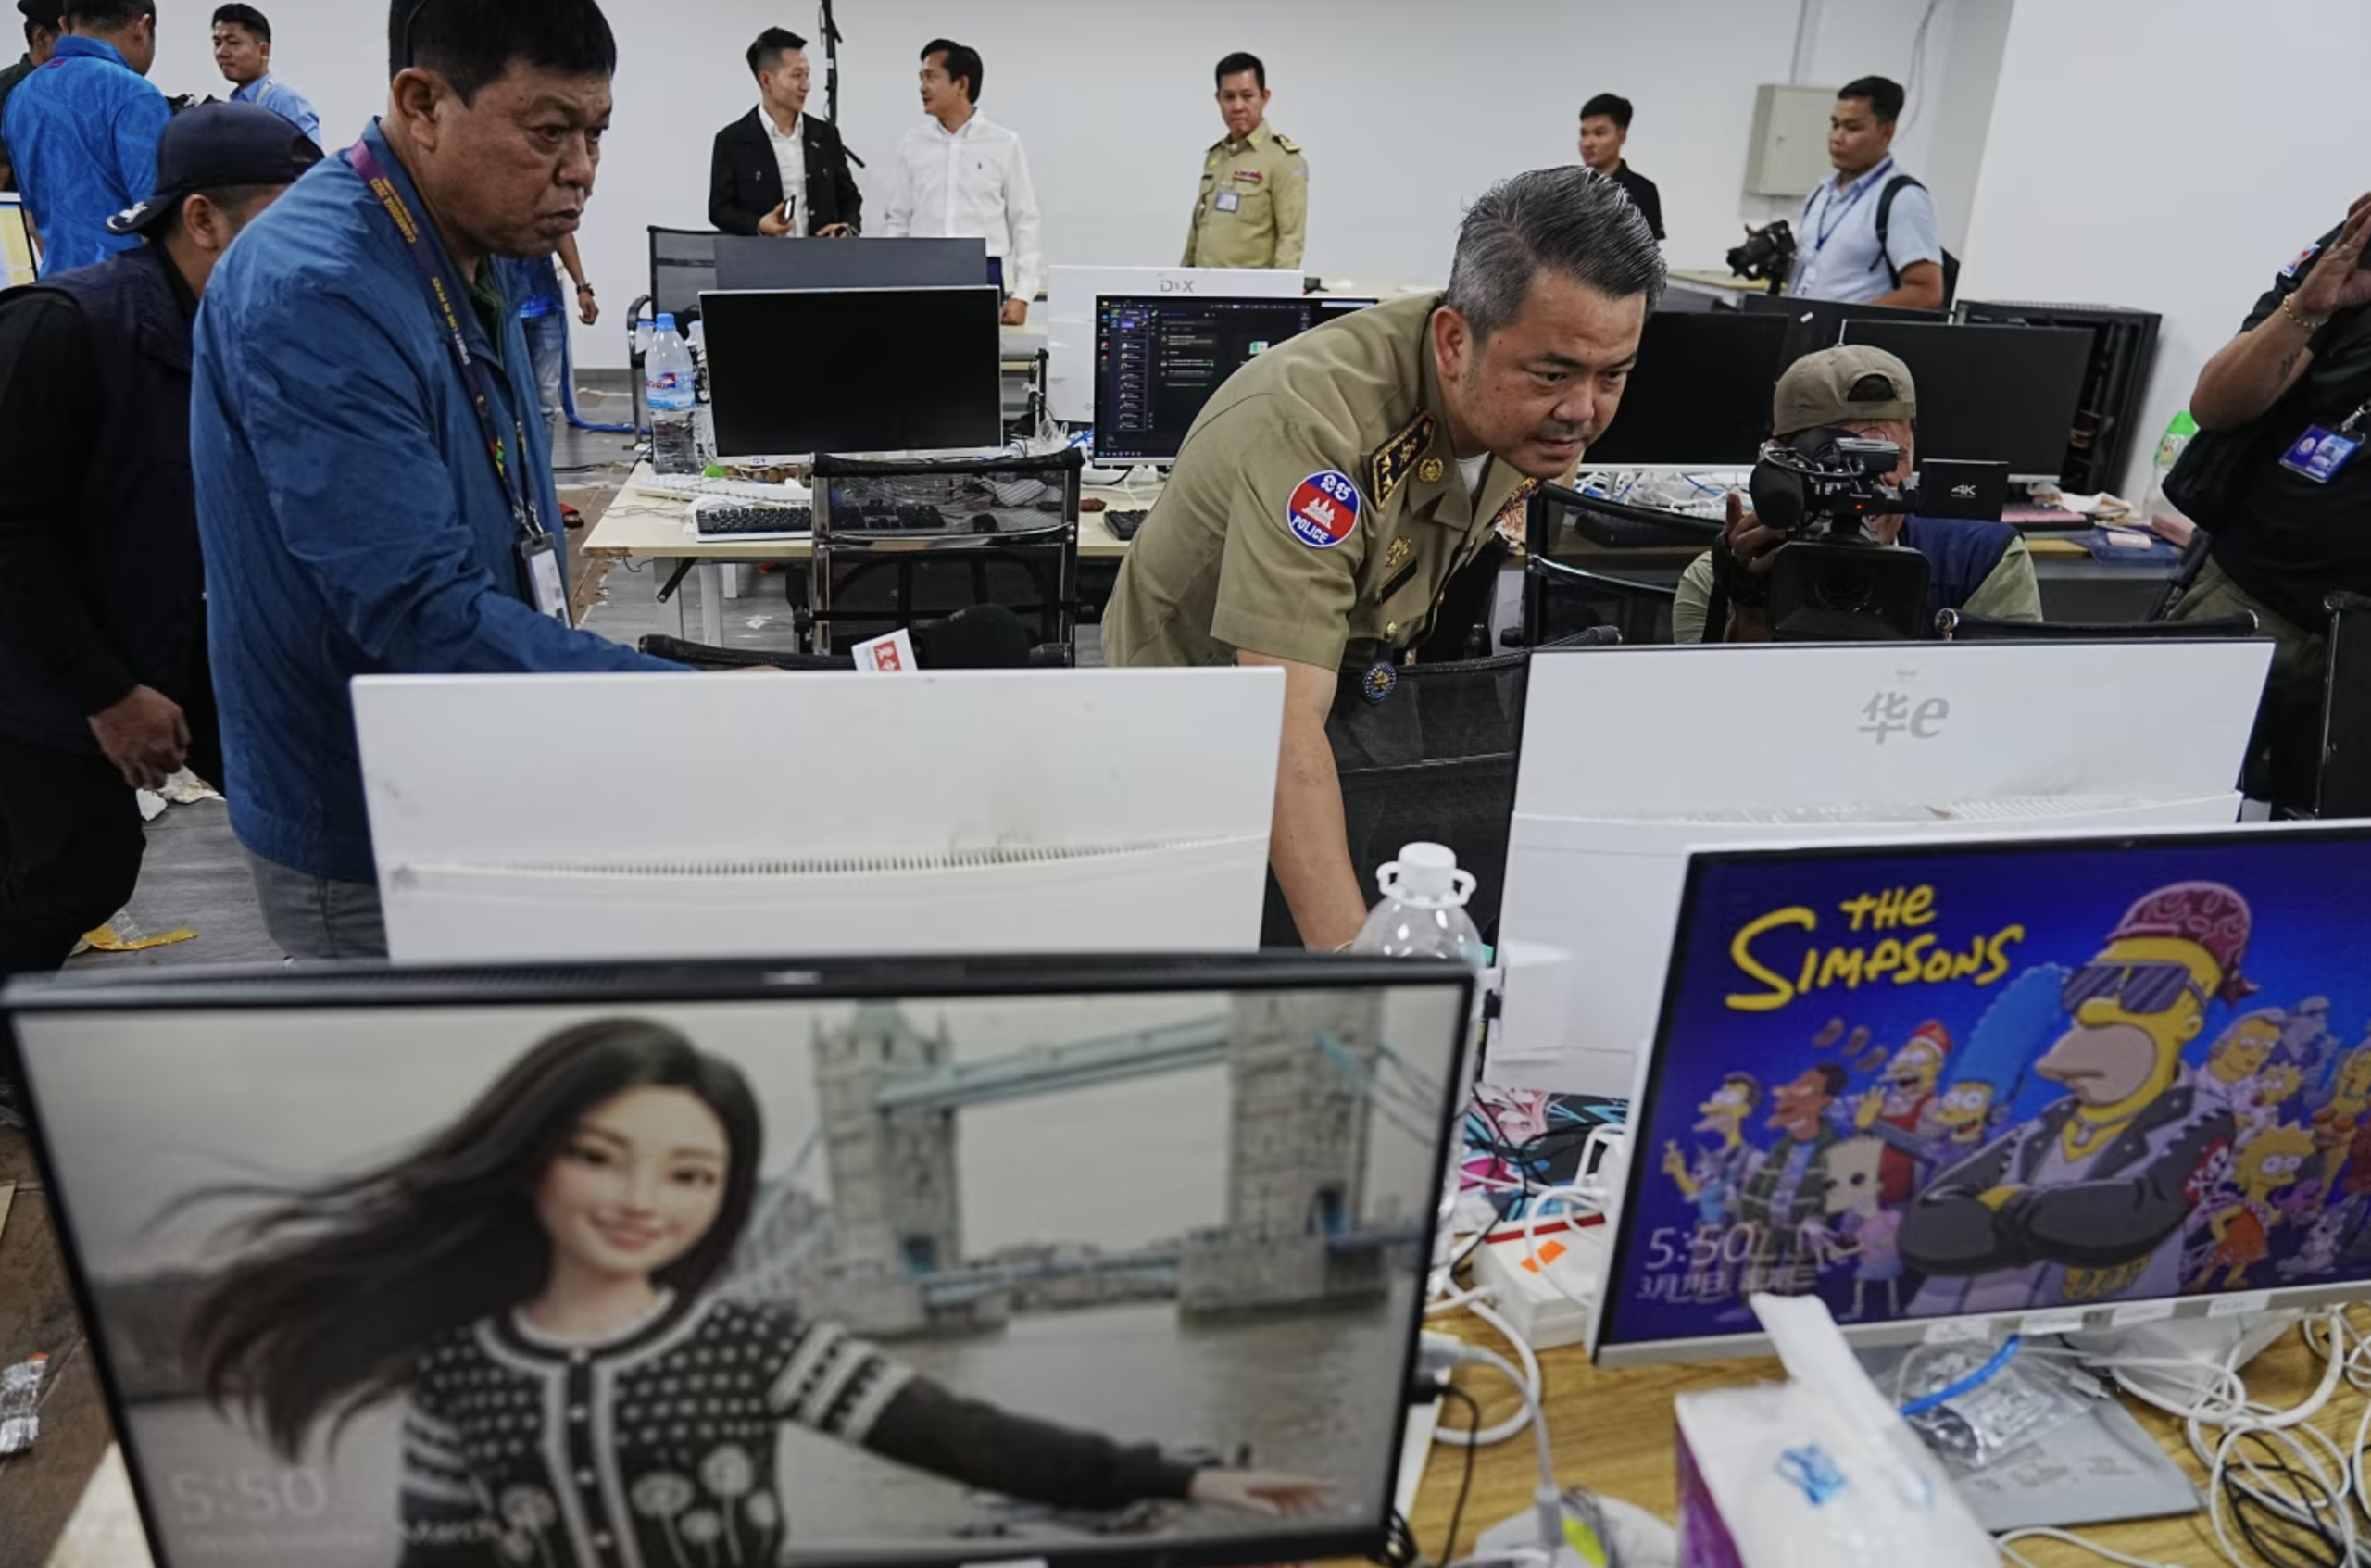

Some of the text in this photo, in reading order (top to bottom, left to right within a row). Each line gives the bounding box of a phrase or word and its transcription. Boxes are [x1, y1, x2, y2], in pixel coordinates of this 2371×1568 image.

[1951, 484, 1976, 495] 4K
[1292, 514, 1330, 544] POLICE
[1644, 1222, 1756, 1270] 5:50
[169, 1466, 326, 1524] 5:50
